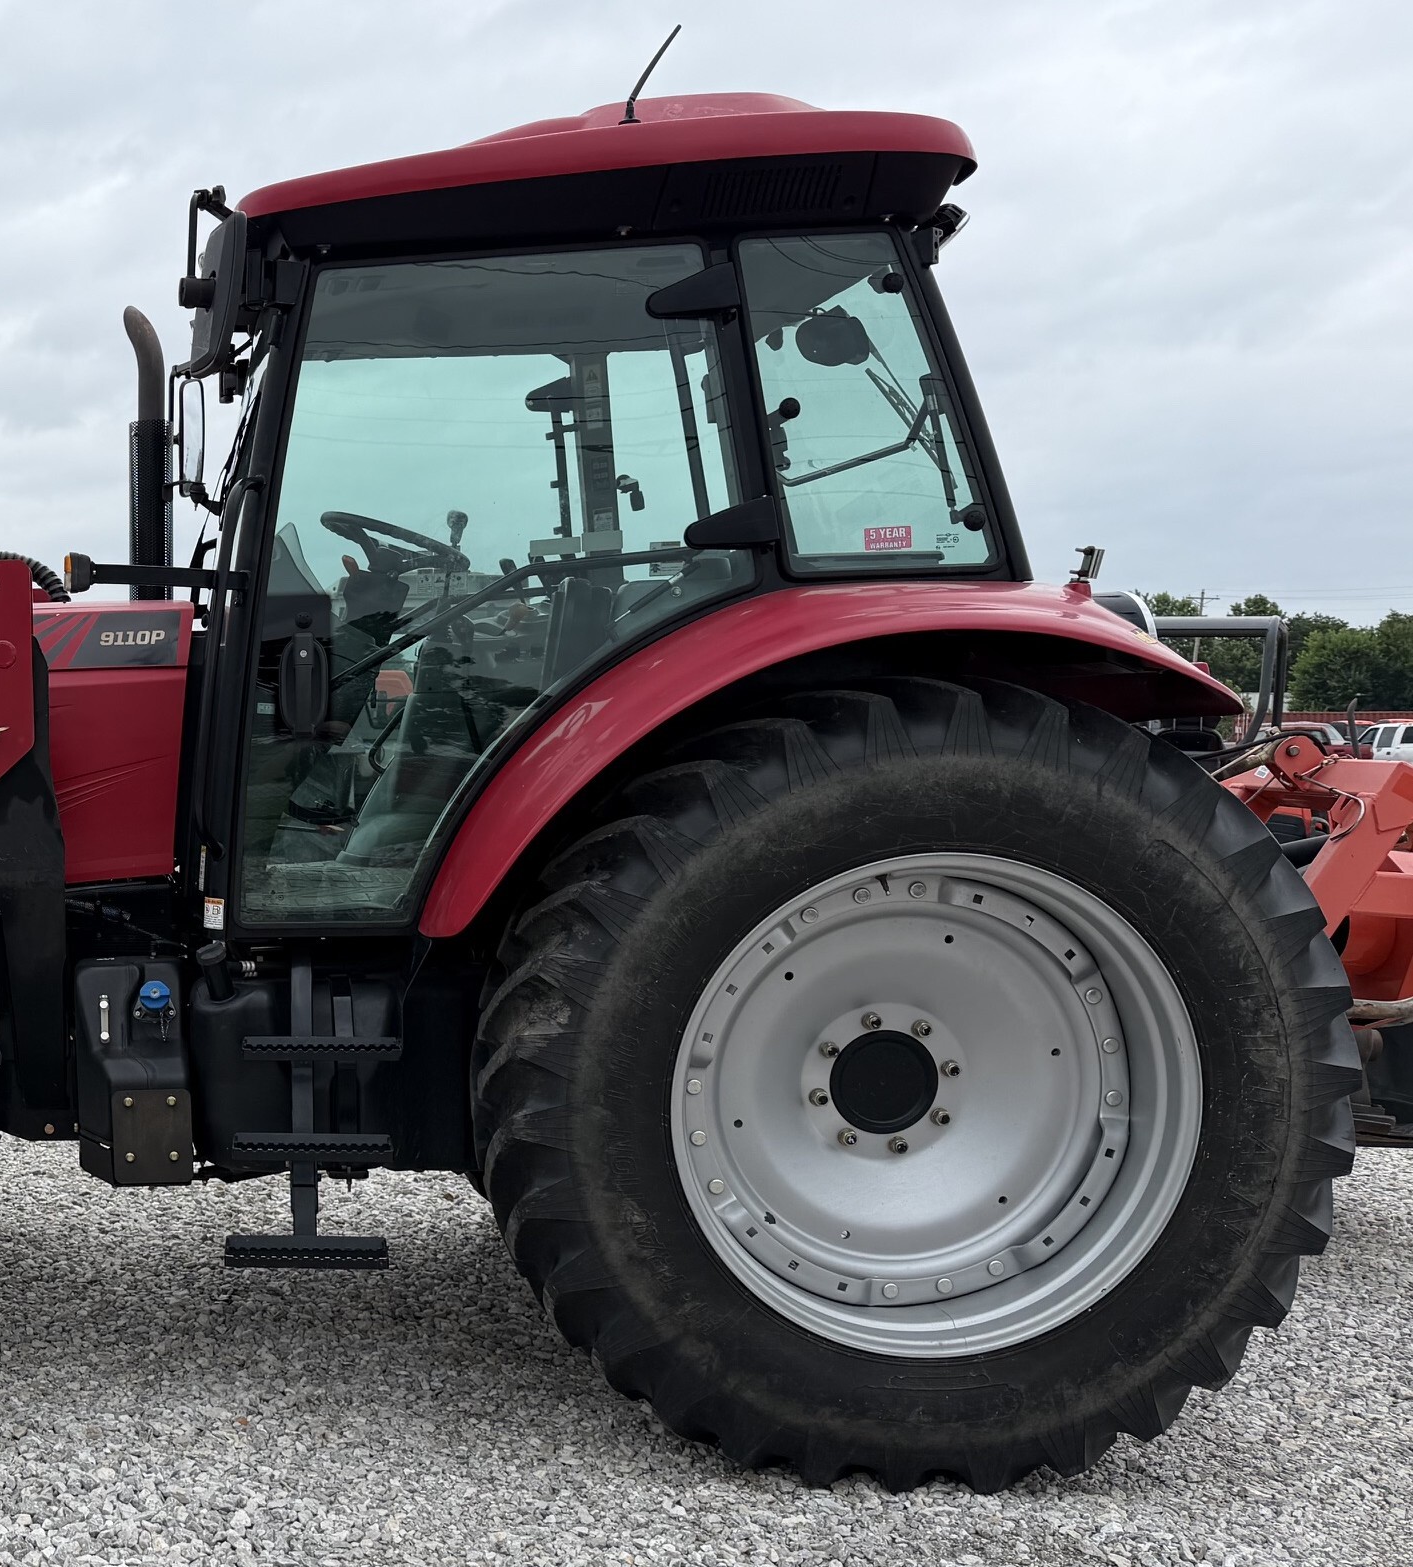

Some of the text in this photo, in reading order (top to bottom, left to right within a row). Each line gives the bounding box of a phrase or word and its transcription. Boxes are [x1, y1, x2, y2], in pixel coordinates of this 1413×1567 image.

[869, 527, 906, 539] 5 YEAR
[869, 541, 907, 549] WARRANTY
[99, 630, 165, 646] 9110P
